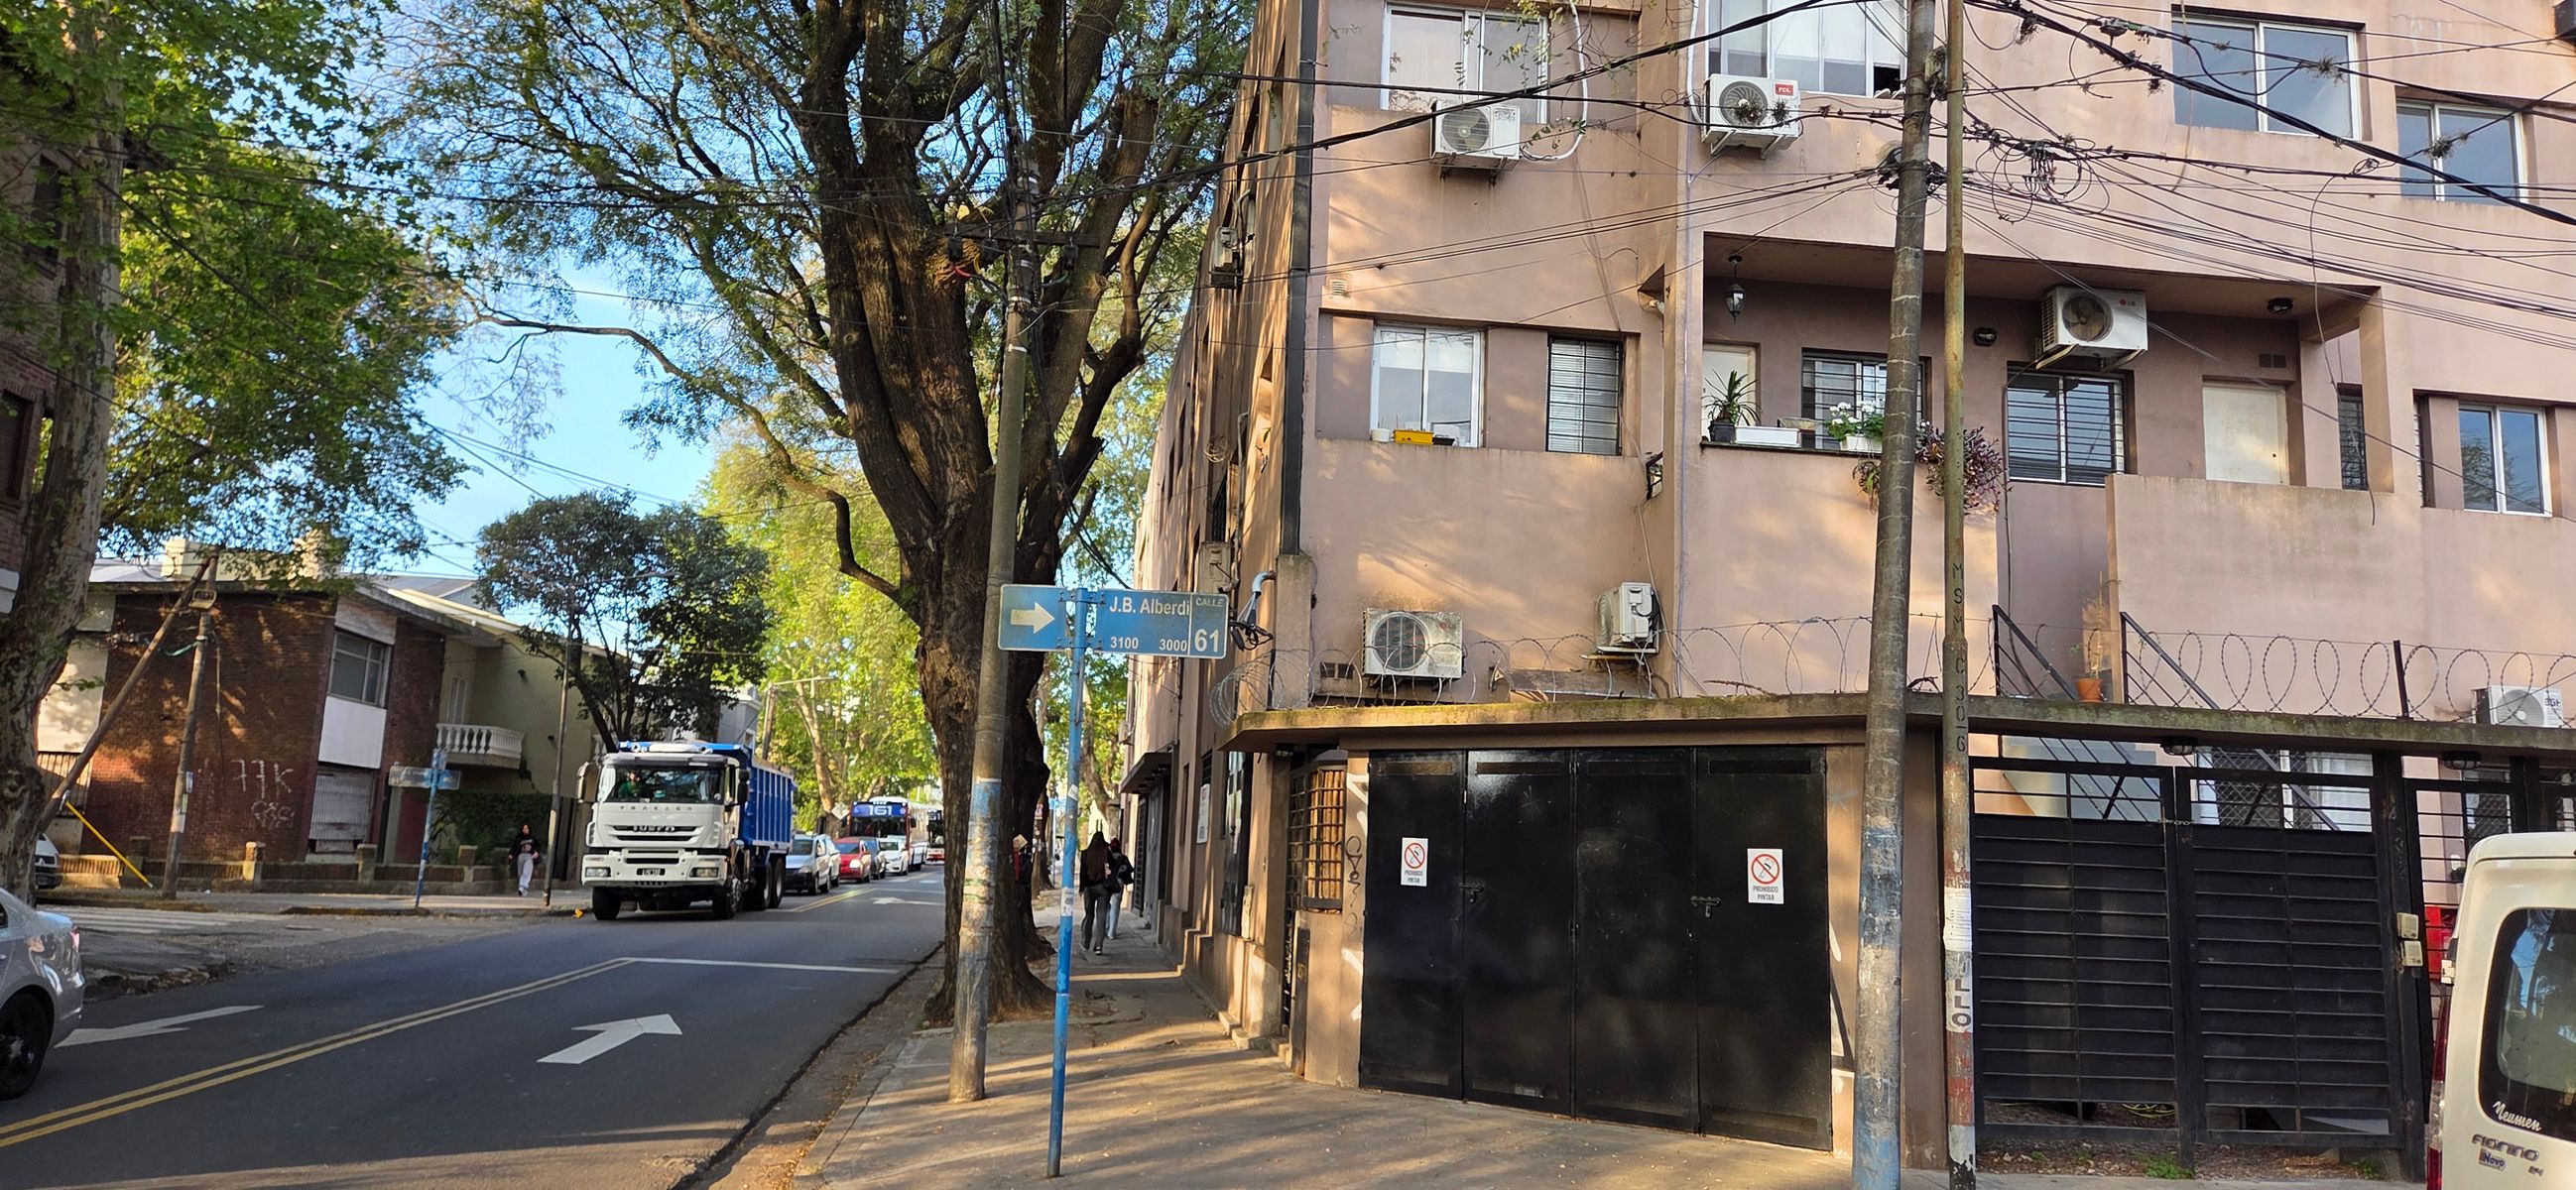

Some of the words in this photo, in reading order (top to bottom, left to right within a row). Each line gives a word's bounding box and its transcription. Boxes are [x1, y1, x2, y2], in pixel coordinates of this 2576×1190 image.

[1109, 596, 1136, 613] J.B.
[1140, 597, 1190, 615] Alberdi
[1195, 597, 1224, 607] CALLE
[1110, 636, 1139, 649] 3100
[1159, 639, 1187, 652] 3000
[1194, 629, 1219, 652] 61
[869, 805, 893, 815] 161
[2493, 1101, 2541, 1131] Neumen
